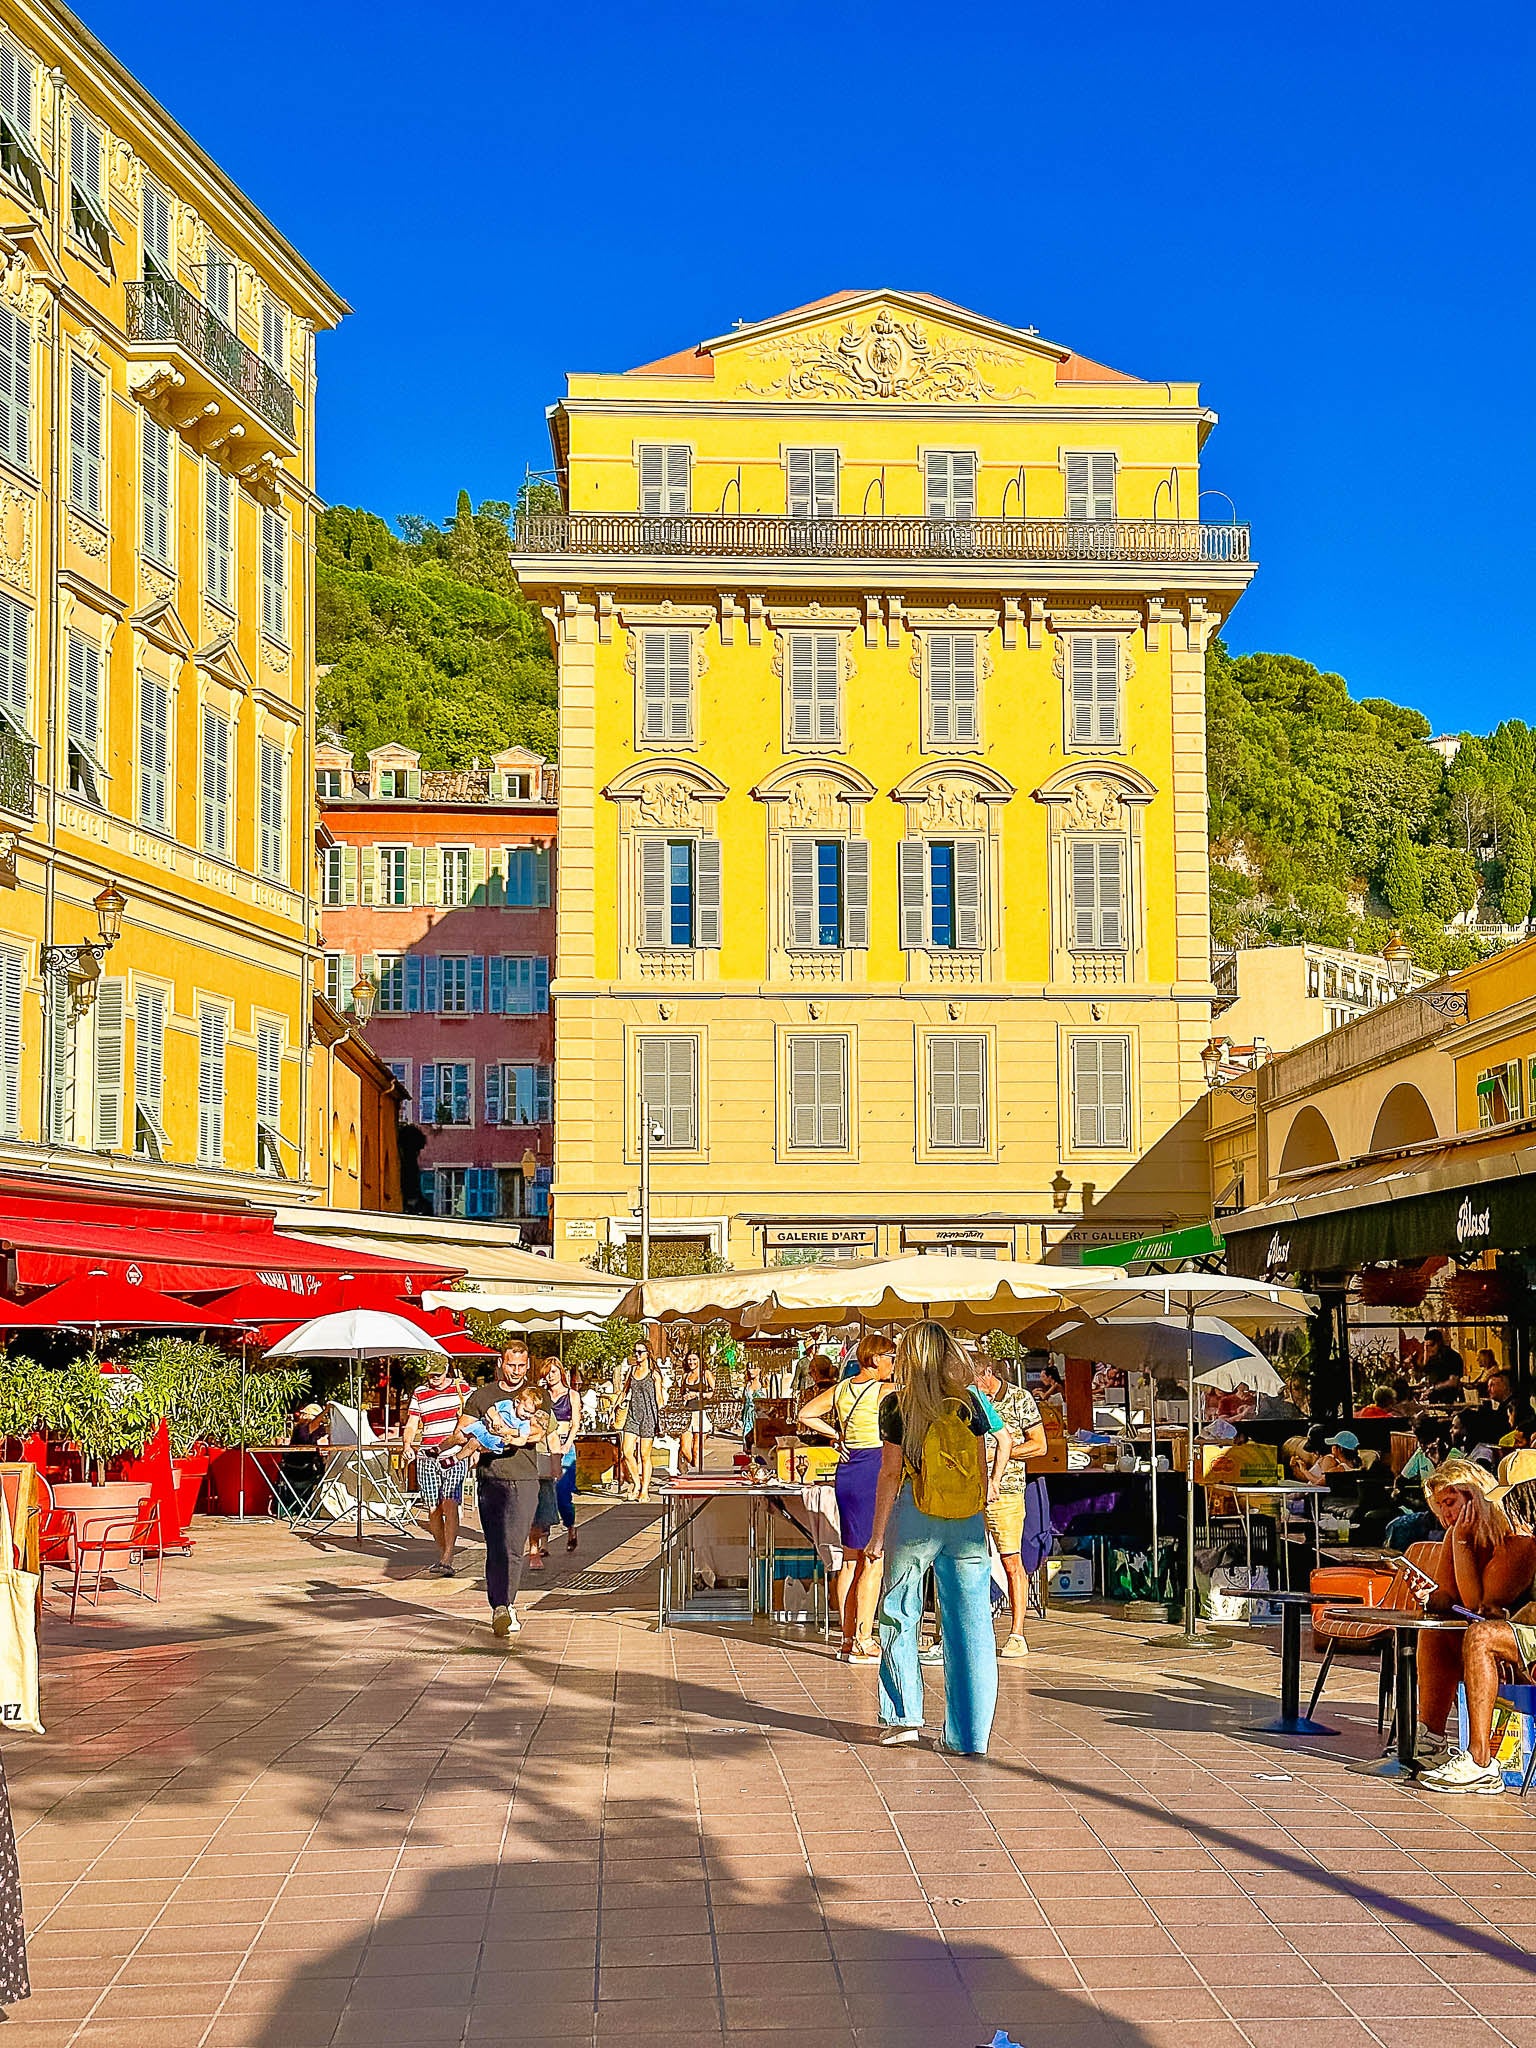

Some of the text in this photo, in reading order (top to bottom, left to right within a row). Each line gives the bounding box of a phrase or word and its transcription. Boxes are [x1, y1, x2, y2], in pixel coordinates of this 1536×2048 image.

[1456, 1195, 1490, 1243] Blast
[777, 1232, 866, 1241] GALERIE D'ART
[1065, 1232, 1145, 1241] ART GALLERY
[1266, 1230, 1290, 1268] Blast
